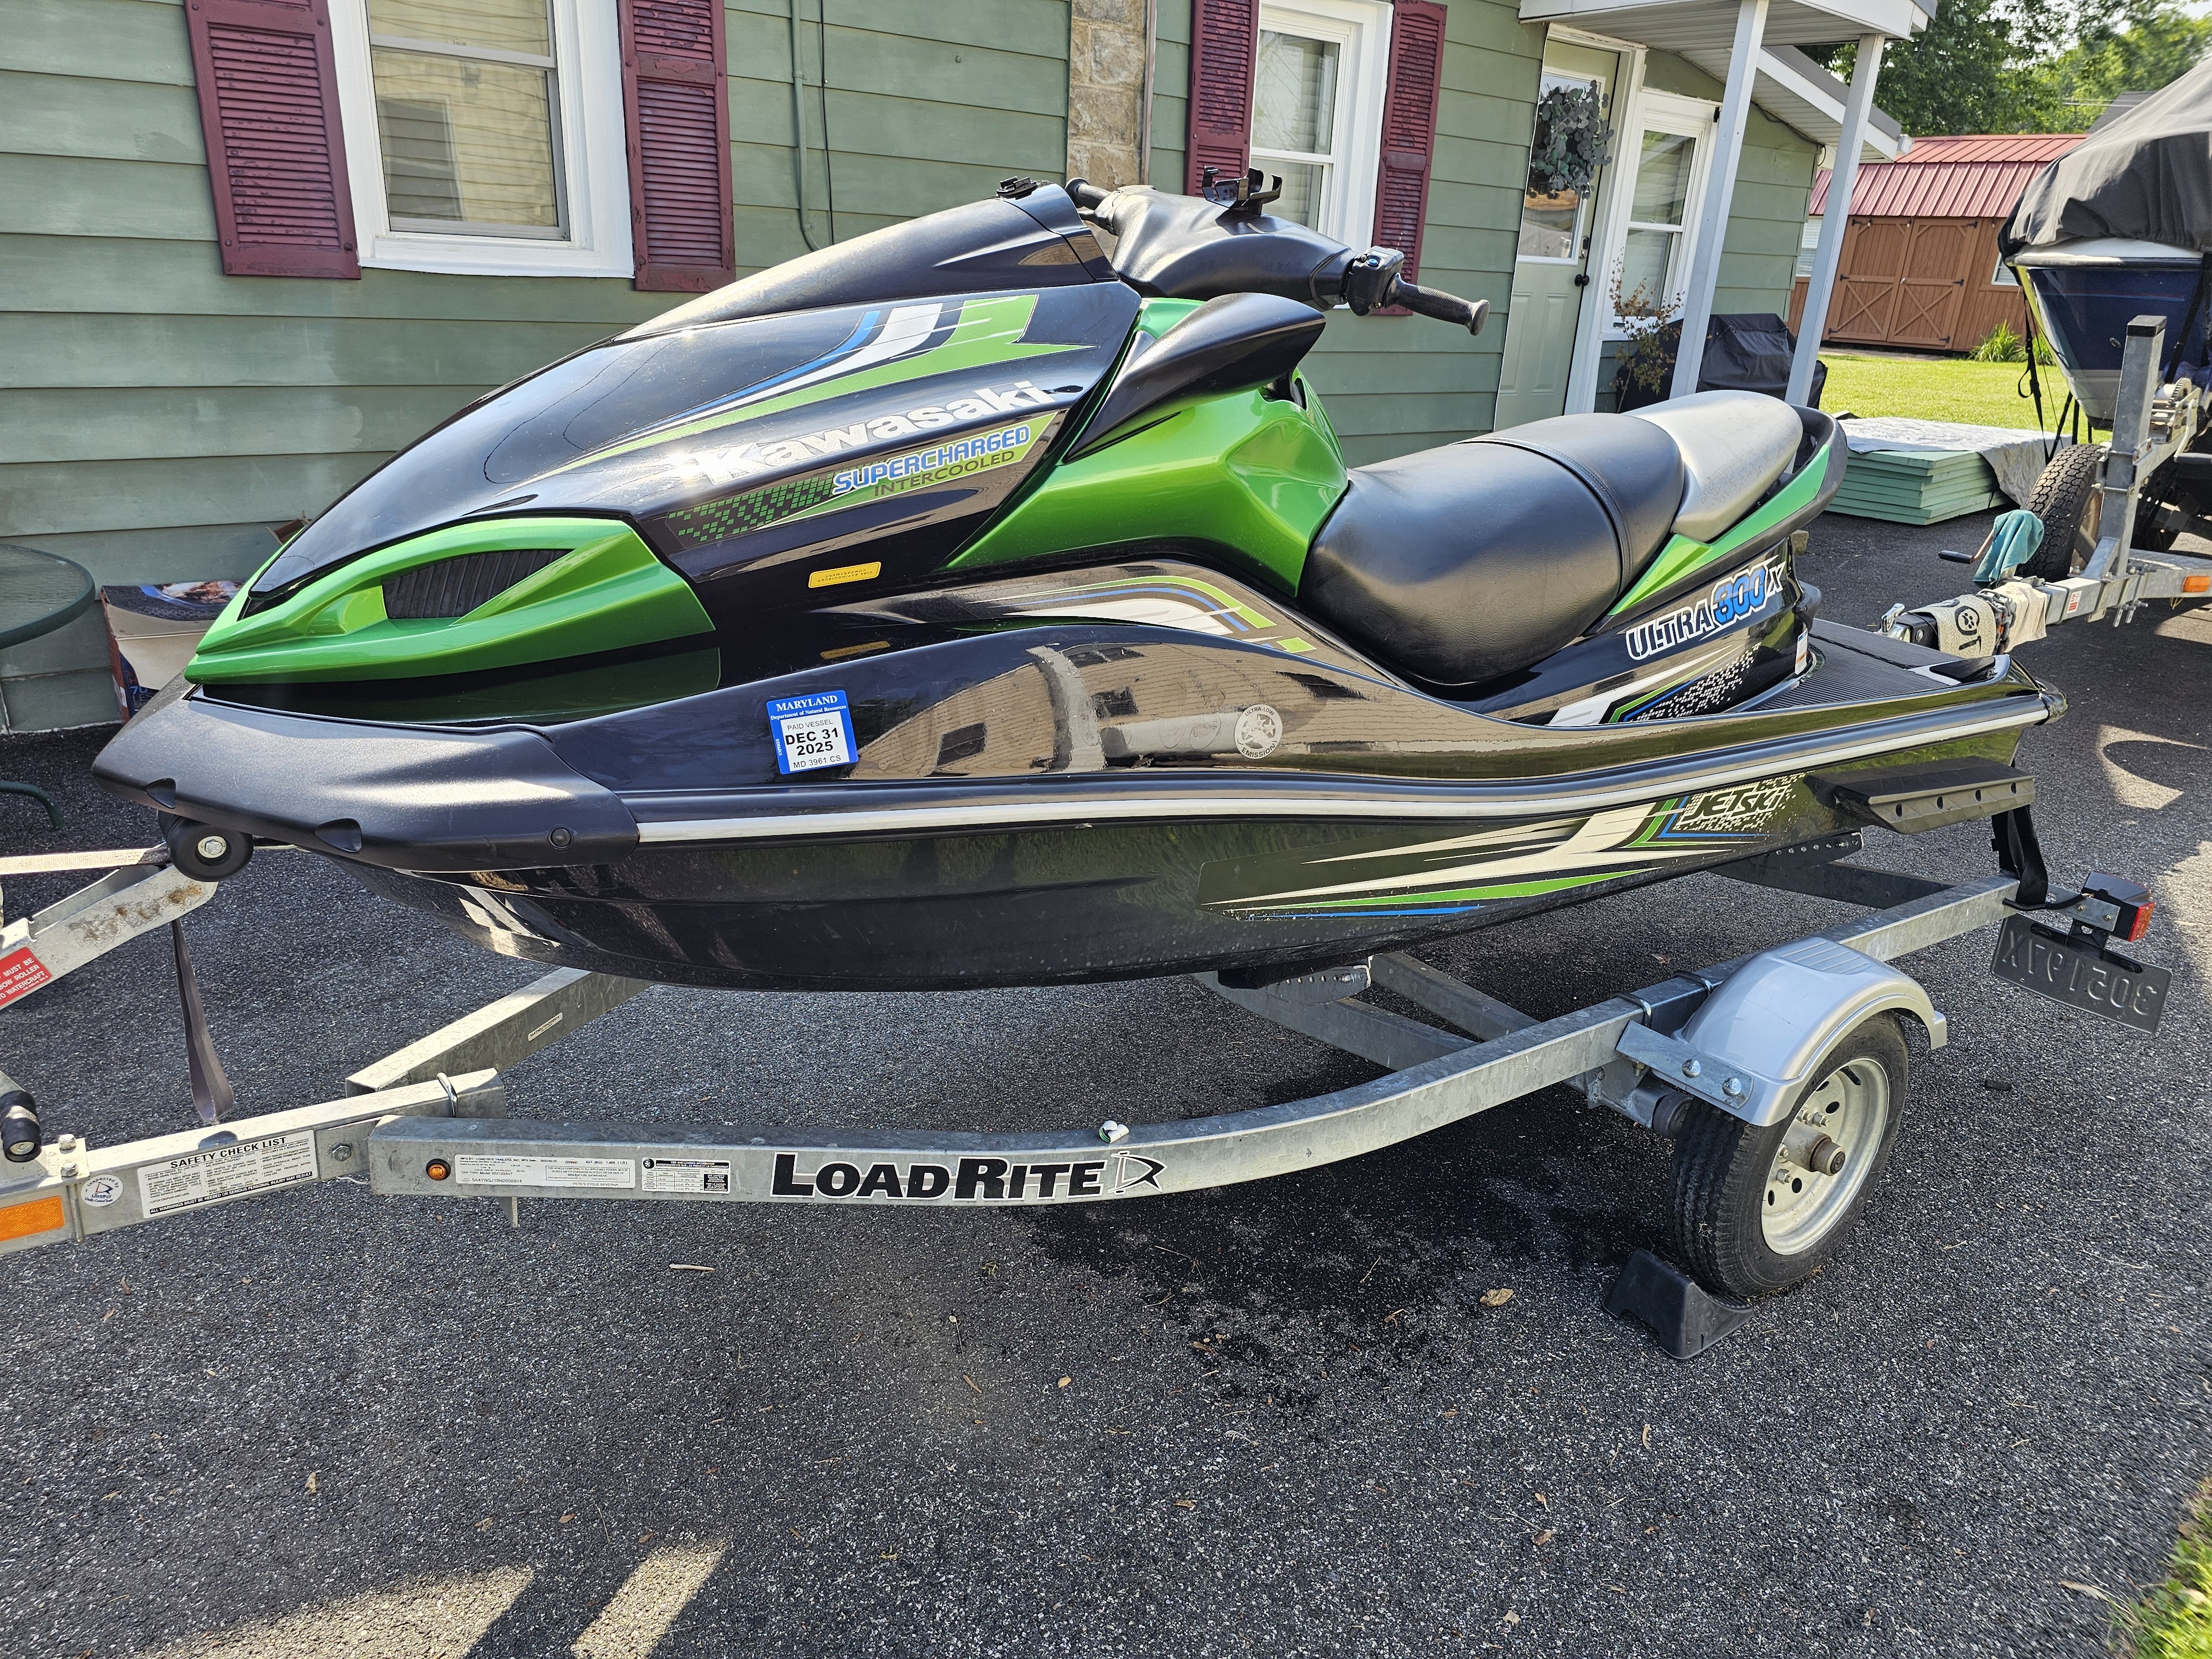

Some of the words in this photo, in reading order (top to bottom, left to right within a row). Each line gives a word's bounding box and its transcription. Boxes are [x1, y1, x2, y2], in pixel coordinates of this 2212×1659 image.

[695, 380, 1056, 485] Kawasaki
[833, 426, 1030, 494] SUPERCHARGED
[875, 451, 1015, 496] INTERCOOLED
[1625, 598, 1715, 660] ULTRA
[776, 695, 837, 712] MARYLAND
[805, 719, 833, 728] VESSEL
[785, 731, 816, 745] DEC
[822, 728, 838, 739] 31
[796, 741, 833, 756] 2025
[1241, 743, 1275, 758] EMISSION
[808, 758, 827, 766] 3961
[3, 964, 22, 977] MUST
[23, 957, 34, 966] BE
[14, 964, 40, 981] ROLLER
[6, 970, 45, 995] WATERCRAFT
[170, 1152, 216, 1168] SAFETY
[220, 1142, 259, 1157] CHECK
[262, 1136, 286, 1148] LIST
[87, 1177, 116, 1187] Inspected
[159, 1203, 184, 1211] WARNINGS
[248, 1182, 270, 1191] PERSONAL
